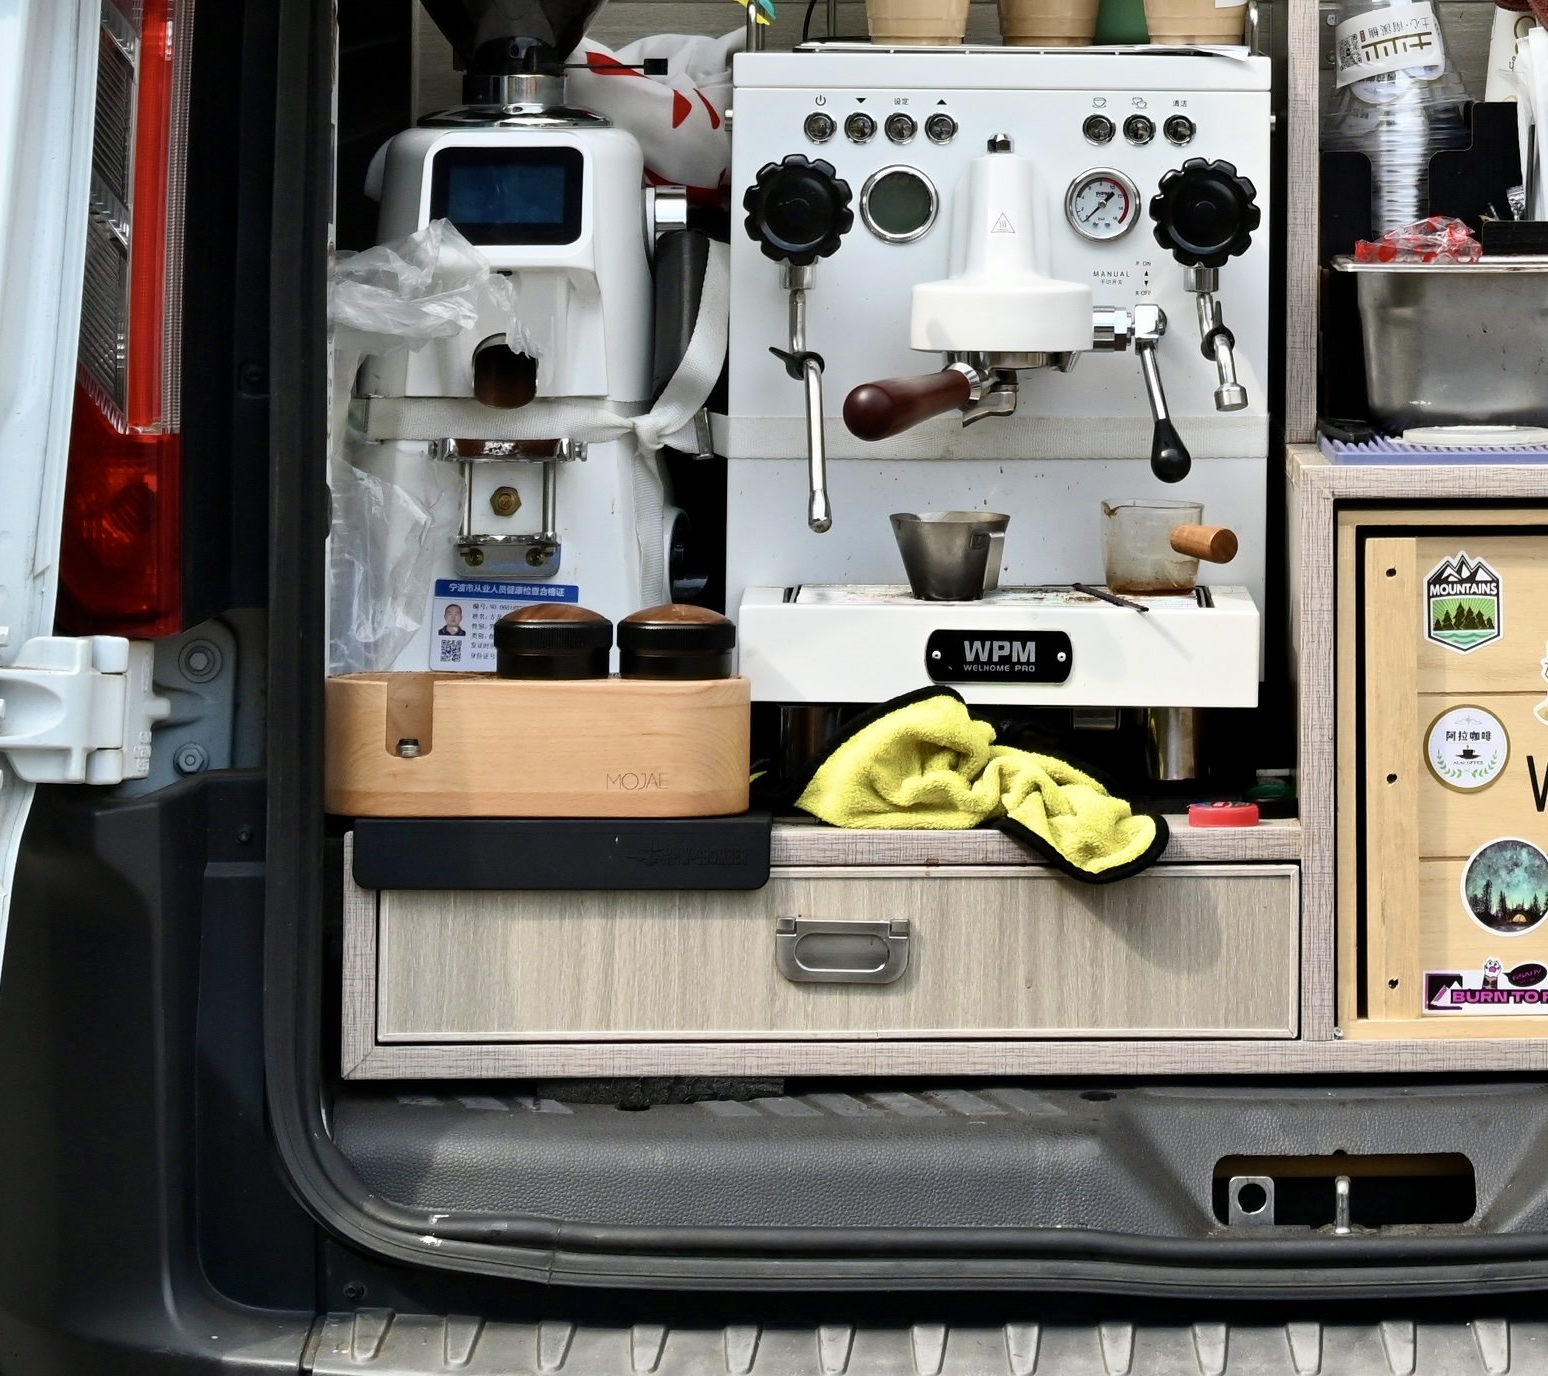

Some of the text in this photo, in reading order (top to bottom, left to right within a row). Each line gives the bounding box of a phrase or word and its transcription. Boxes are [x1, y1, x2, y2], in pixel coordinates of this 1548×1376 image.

[1093, 270, 1130, 278] MANUAL
[1429, 582, 1498, 596] MOUNTAINS
[963, 640, 1036, 663] WPM
[963, 664, 1035, 673] WELHOME PRO
[1445, 730, 1492, 742] 阿拉咖啡
[606, 772, 669, 791] MOJAE
[1451, 989, 1509, 1004] BURN
[1511, 989, 1539, 1003] TO
